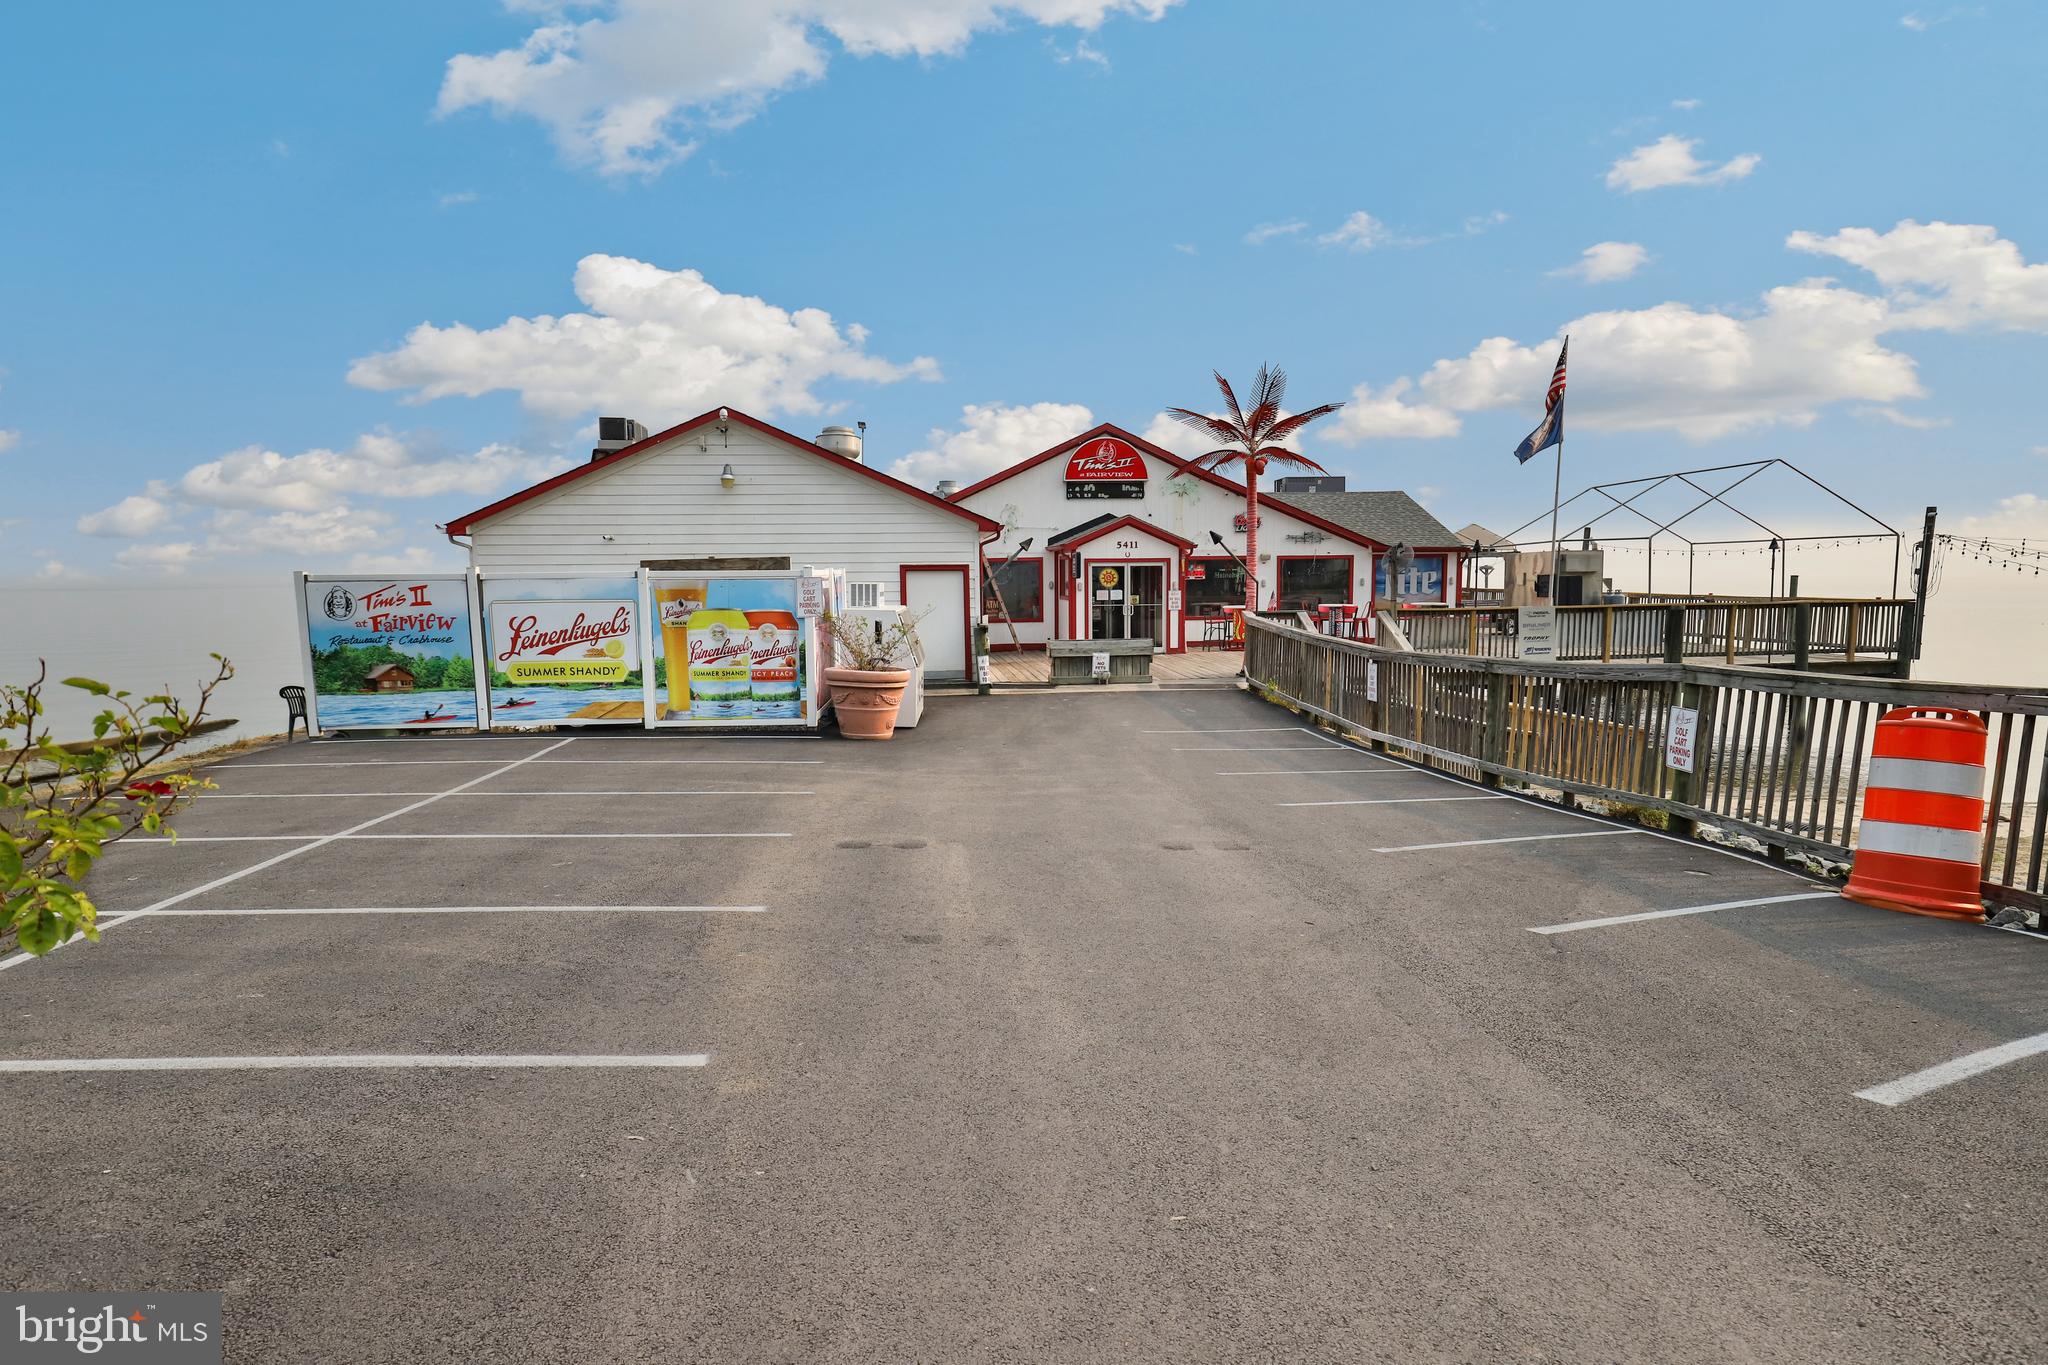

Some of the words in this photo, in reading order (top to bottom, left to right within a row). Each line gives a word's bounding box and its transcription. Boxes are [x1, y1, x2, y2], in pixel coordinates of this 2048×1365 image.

[1072, 453, 1117, 471] Tim's
[1117, 456, 1137, 468] II
[1116, 541, 1139, 549] 5411
[358, 584, 407, 612] Tim's
[408, 584, 433, 607] II
[355, 620, 368, 628] at
[368, 613, 456, 633] Fairview
[499, 606, 631, 662] Leinenkugel's
[398, 635, 454, 646] Crabhouse
[688, 635, 753, 666] Leinenkugel's
[516, 668, 566, 677] SUMMER
[569, 666, 617, 676] SHANDY
[1675, 726, 1688, 737] GOLF
[1674, 736, 1688, 747] CART
[1669, 745, 1691, 758] PARKING
[1672, 756, 1687, 767] ONLY
